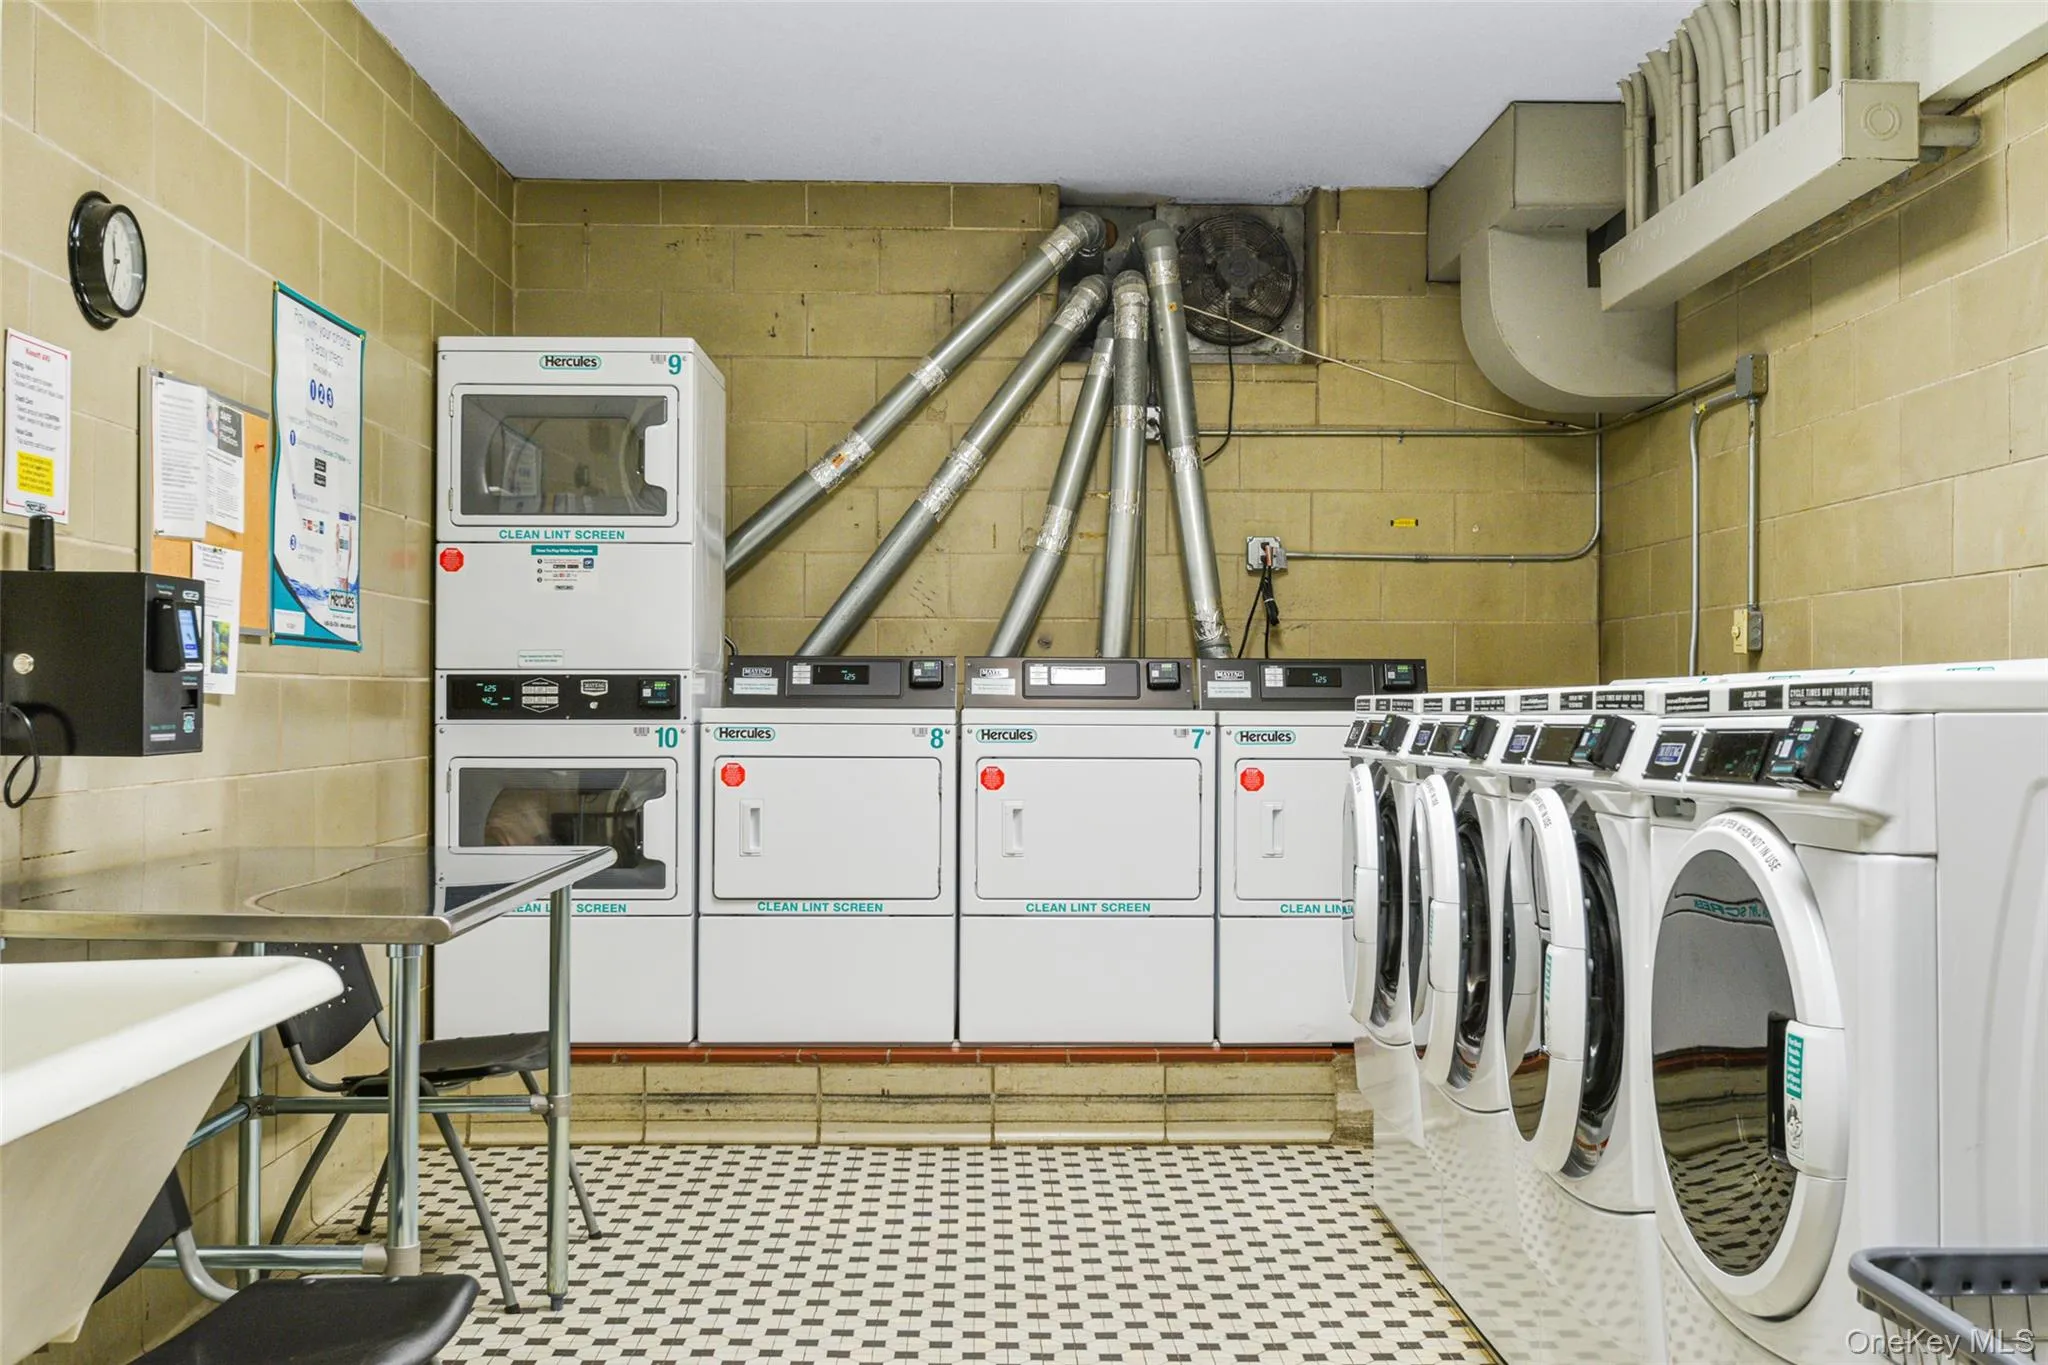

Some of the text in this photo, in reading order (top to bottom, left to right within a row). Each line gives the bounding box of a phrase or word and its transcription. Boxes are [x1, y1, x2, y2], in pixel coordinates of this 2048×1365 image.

[546, 355, 597, 367] Hercules
[668, 354, 682, 375] 9
[220, 410, 232, 424] SAFE
[499, 529, 626, 540] CLEAN LINT SCREEN
[330, 593, 355, 609] Hercules
[1216, 671, 1243, 679] MAYTAG
[1790, 688, 1805, 698] CYCLE
[1805, 688, 1821, 697] TIMES
[1822, 687, 1833, 697] MAY
[1833, 687, 1848, 697] VARY
[1848, 687, 1860, 697] DUE
[656, 727, 679, 748] 10
[719, 727, 772, 739] Hercules
[930, 727, 944, 749] 8
[981, 729, 1033, 741] Hercules
[1192, 728, 1204, 749] 7
[1240, 731, 1292, 742] Hercules
[1750, 833, 1766, 849] NOT
[1759, 844, 1772, 858] IN
[1764, 853, 1783, 872] USE
[576, 903, 627, 913] SCREEN
[759, 902, 884, 913] CLEAN LINT SCREEN
[1026, 902, 1152, 913] CLEAN LINT SCREEN
[1281, 903, 1343, 914] CLEAN LIN
